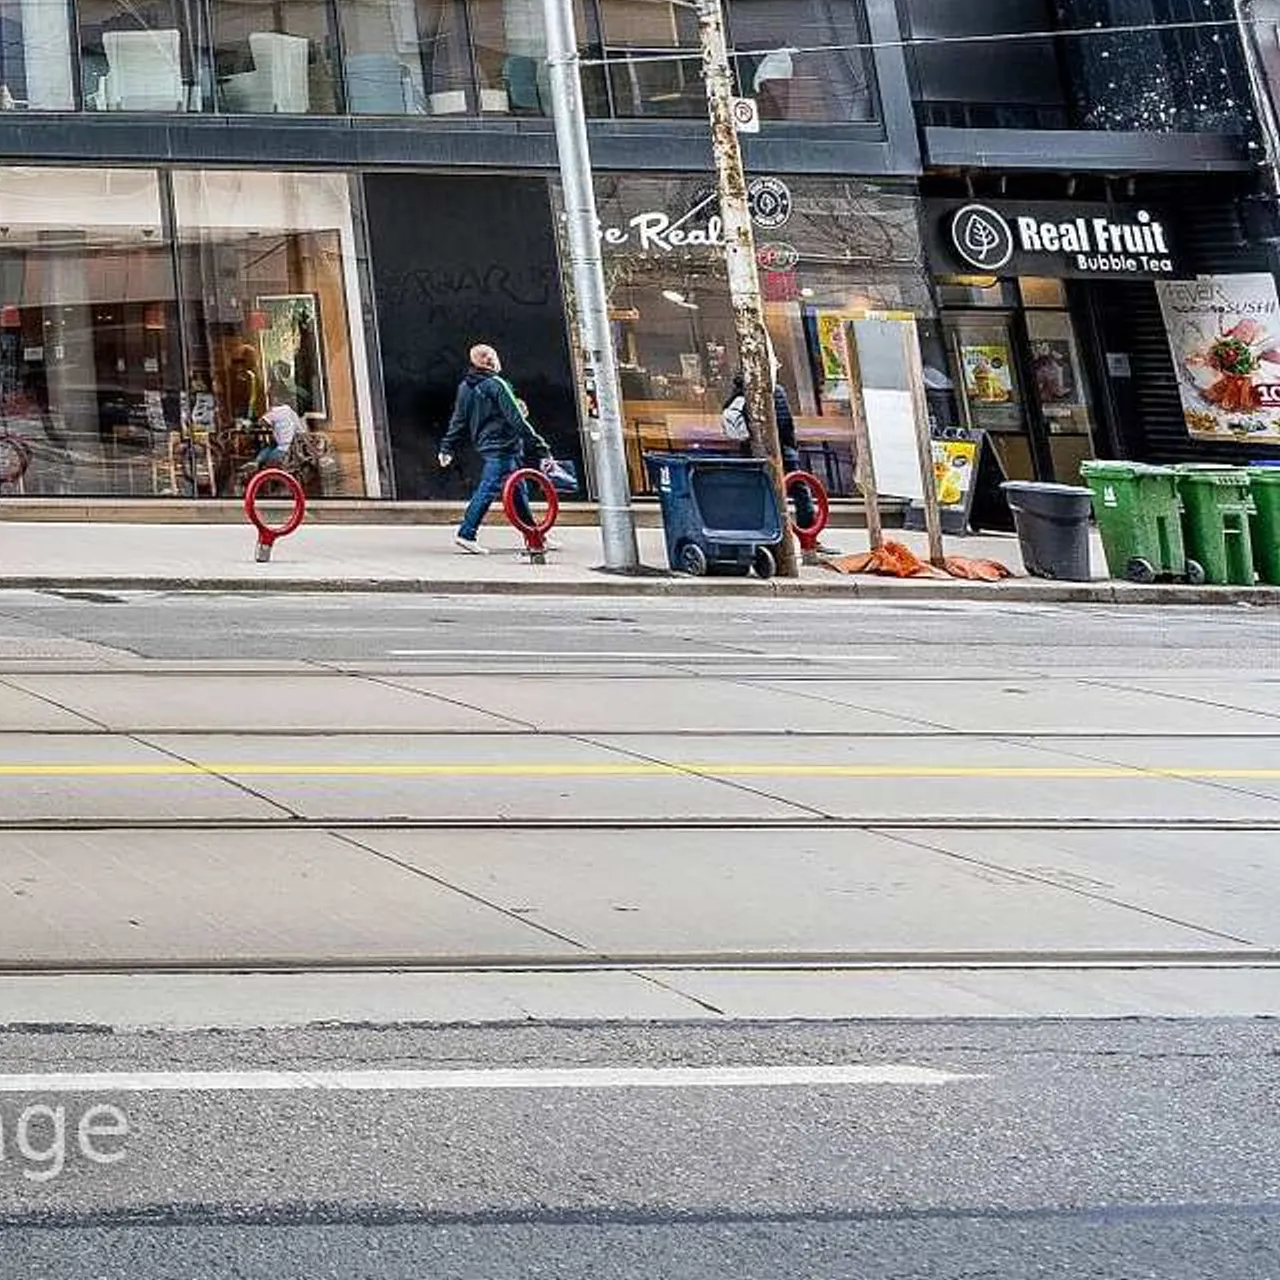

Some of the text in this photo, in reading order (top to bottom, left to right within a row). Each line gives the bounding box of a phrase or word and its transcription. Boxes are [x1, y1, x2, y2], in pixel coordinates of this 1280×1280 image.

[630, 211, 726, 252] Real
[1017, 209, 1169, 254] Real Fruit
[1076, 253, 1173, 272] Bubble Tea
